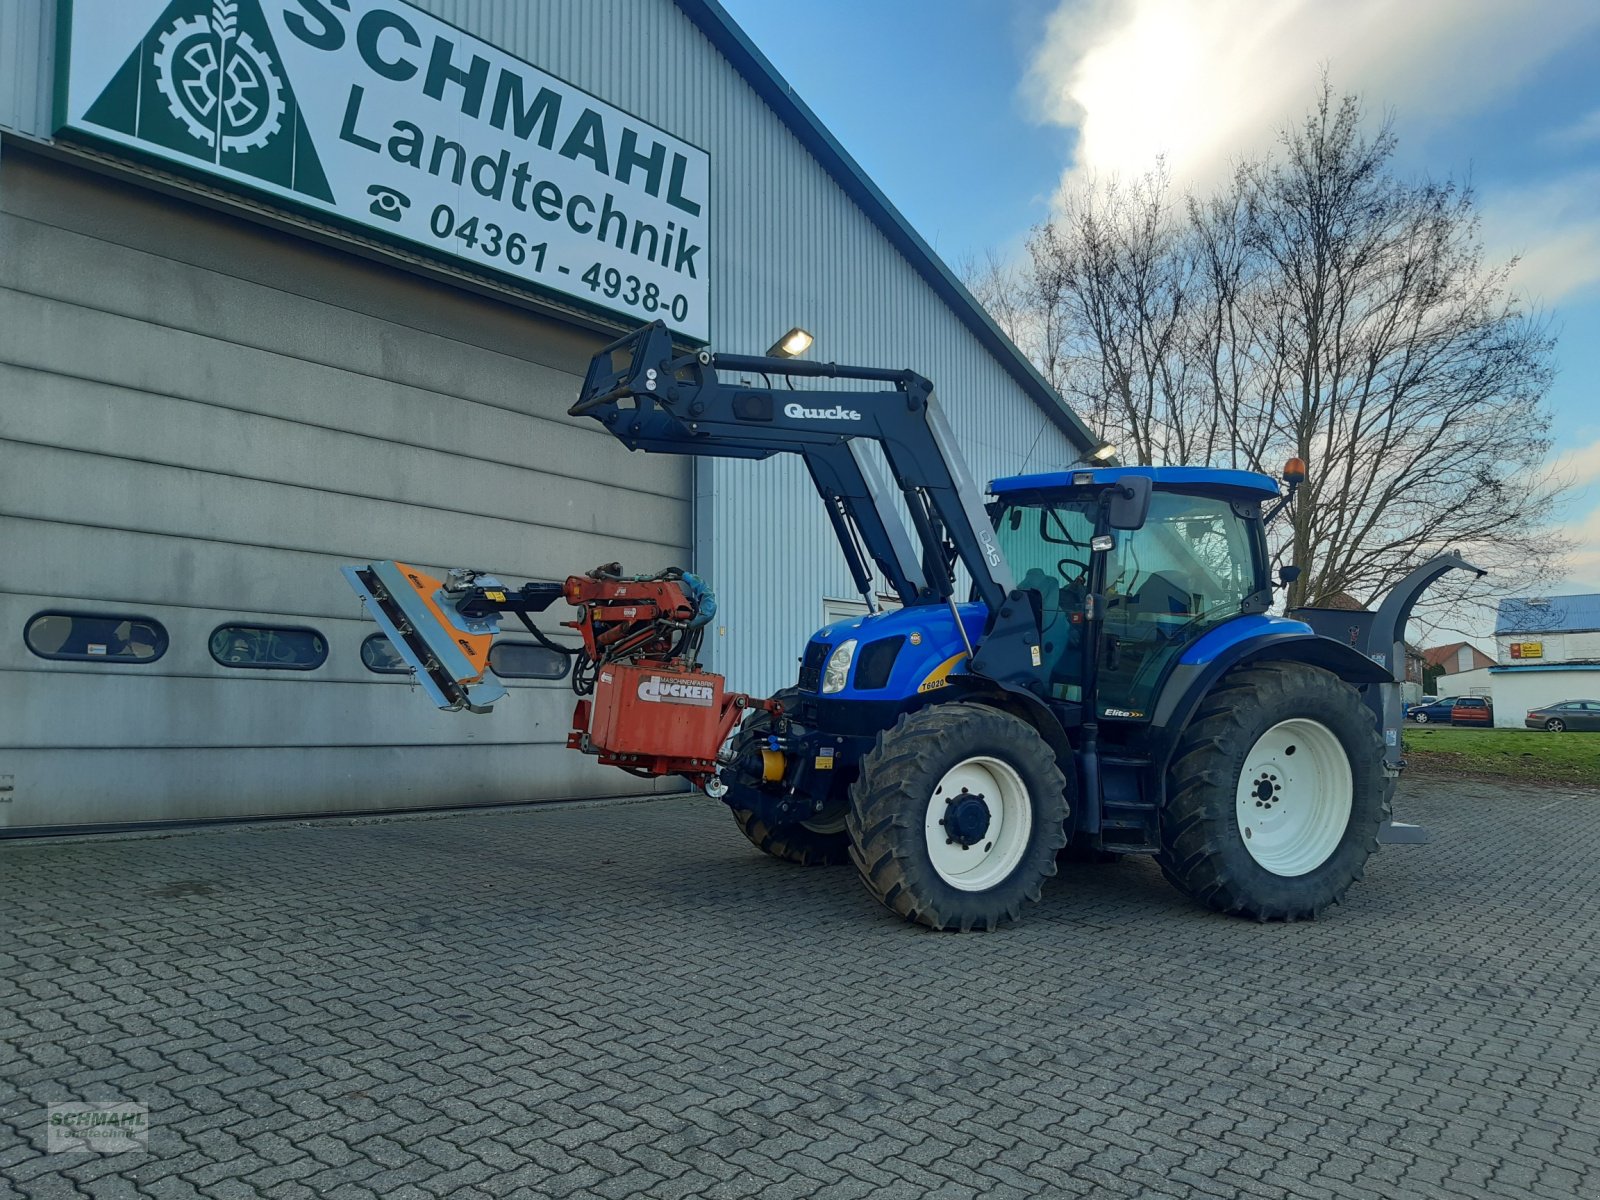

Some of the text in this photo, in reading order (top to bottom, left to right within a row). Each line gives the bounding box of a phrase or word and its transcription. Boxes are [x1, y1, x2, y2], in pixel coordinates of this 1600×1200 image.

[283, 0, 701, 218] SCHMAHL
[339, 84, 701, 279] Landtechnik
[430, 204, 548, 273] 04361
[581, 262, 689, 322] 4938-0
[784, 403, 861, 421] Quicke
[979, 530, 1000, 567] D45
[660, 677, 714, 688] MASCHINENFABRIK
[922, 678, 945, 691] T6020
[1104, 708, 1130, 717] Elite
